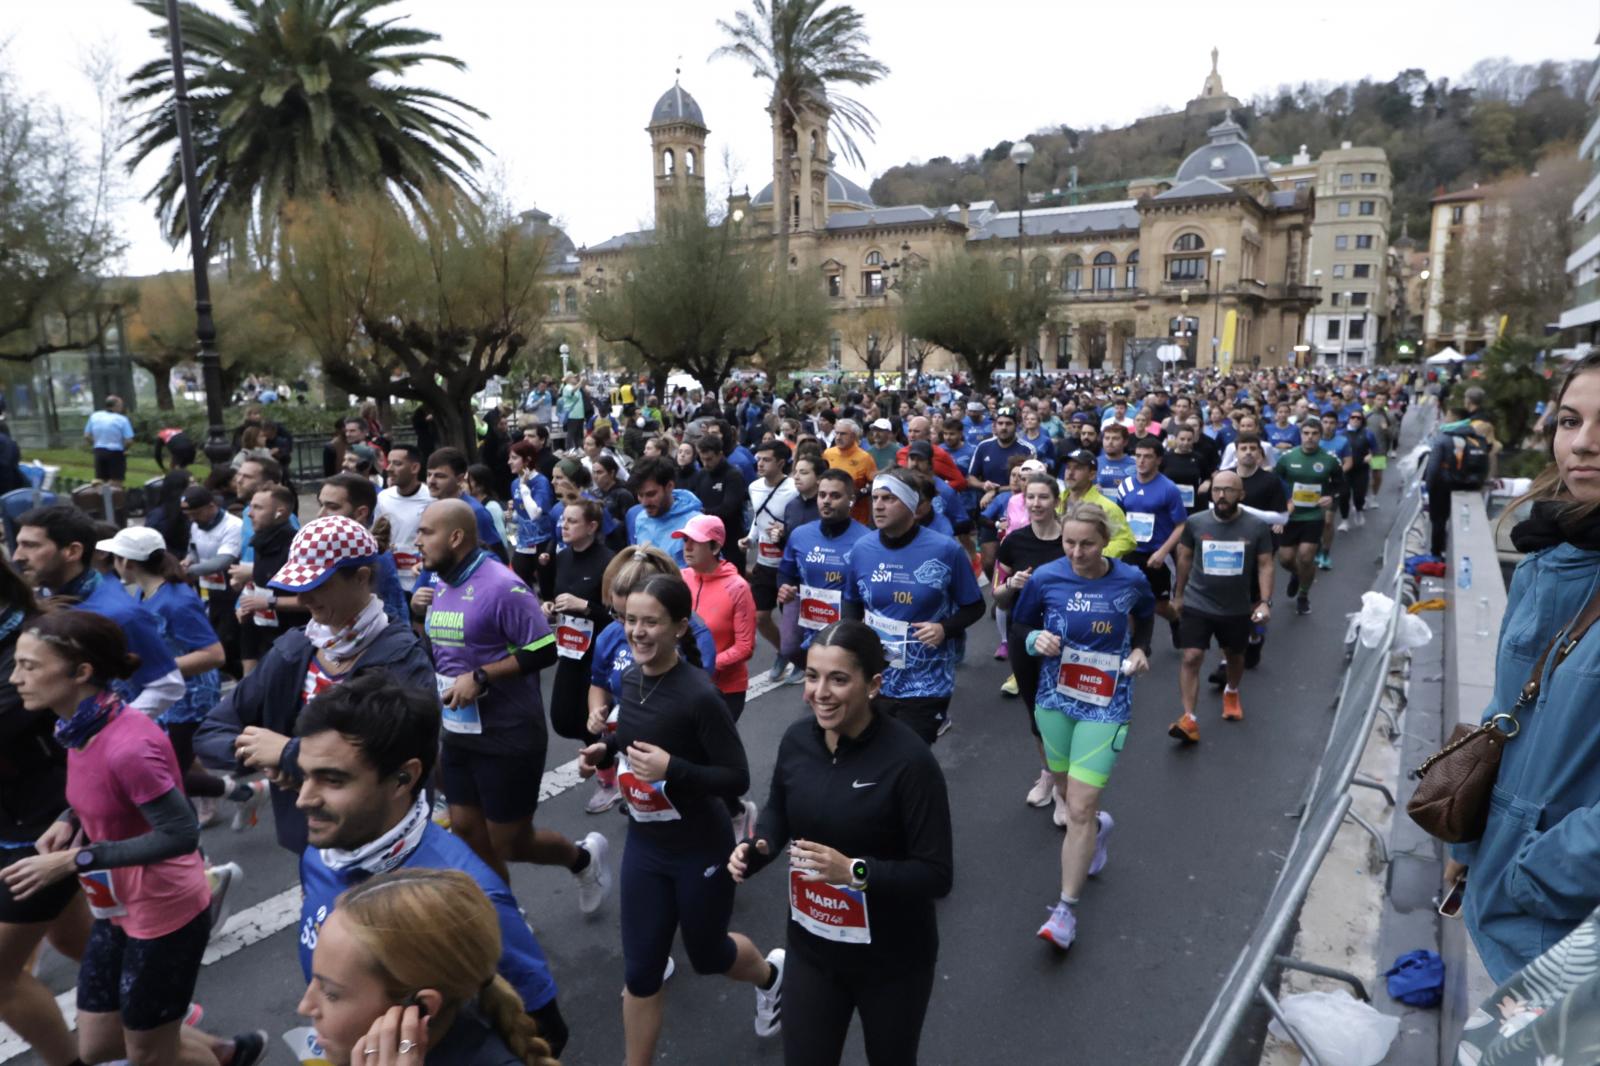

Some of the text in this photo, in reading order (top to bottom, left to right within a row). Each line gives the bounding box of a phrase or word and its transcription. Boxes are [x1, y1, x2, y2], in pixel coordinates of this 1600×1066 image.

[893, 591, 914, 605] 10k
[1091, 620, 1113, 634] 10k
[1080, 674, 1103, 685] INES
[805, 887, 850, 911] MARIA
